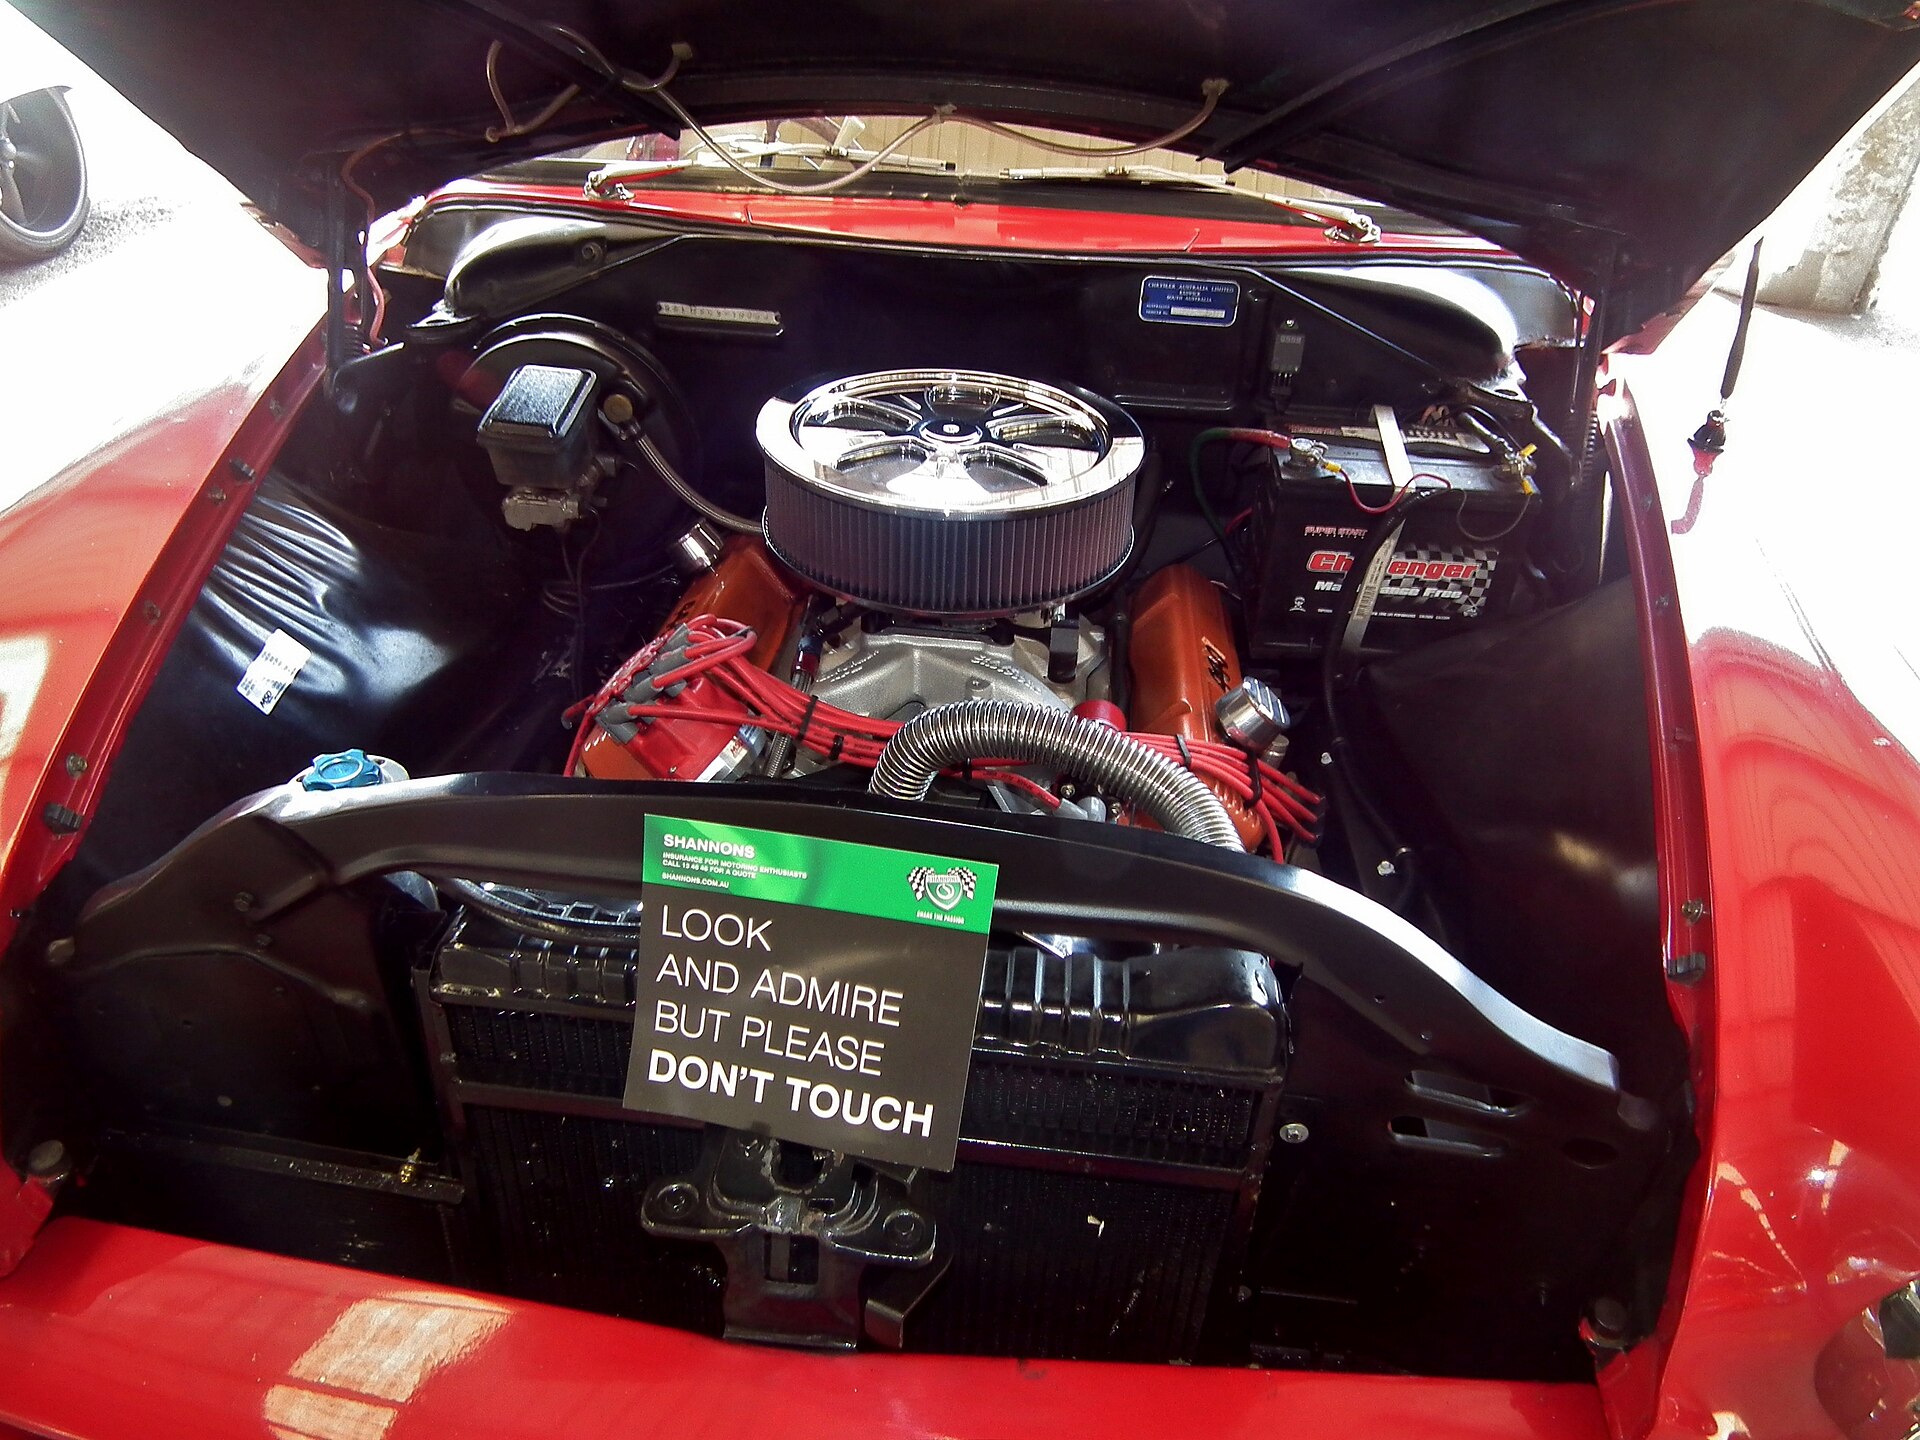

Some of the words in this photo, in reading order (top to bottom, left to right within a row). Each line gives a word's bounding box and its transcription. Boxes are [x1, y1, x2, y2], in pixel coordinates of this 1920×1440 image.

[1178, 284, 1209, 292] AUSTRALIA
[1307, 551, 1479, 579] Chenger
[1422, 586, 1463, 599] Free
[663, 833, 756, 859] SHANNONS
[662, 852, 704, 864] INSURANCE
[704, 857, 720, 866] FOR
[720, 859, 758, 873] MOTORING
[759, 865, 808, 880] ENTHUSIASTS
[662, 859, 681, 868] CALL
[682, 862, 690, 870] 13
[709, 866, 725, 875] FOR
[725, 868, 732, 876] A
[732, 869, 757, 879] QUOTE
[661, 872, 730, 888] SHANNONS.COM.AU
[661, 905, 774, 952] LOOK
[943, 914, 965, 925] PASSION
[656, 954, 740, 994] AND
[750, 968, 905, 1028] ADMIRE
[654, 1000, 731, 1043] BUT
[740, 1016, 885, 1077] PLEASE
[648, 1048, 775, 1104] DON'T
[785, 1075, 934, 1138] TOUCH
